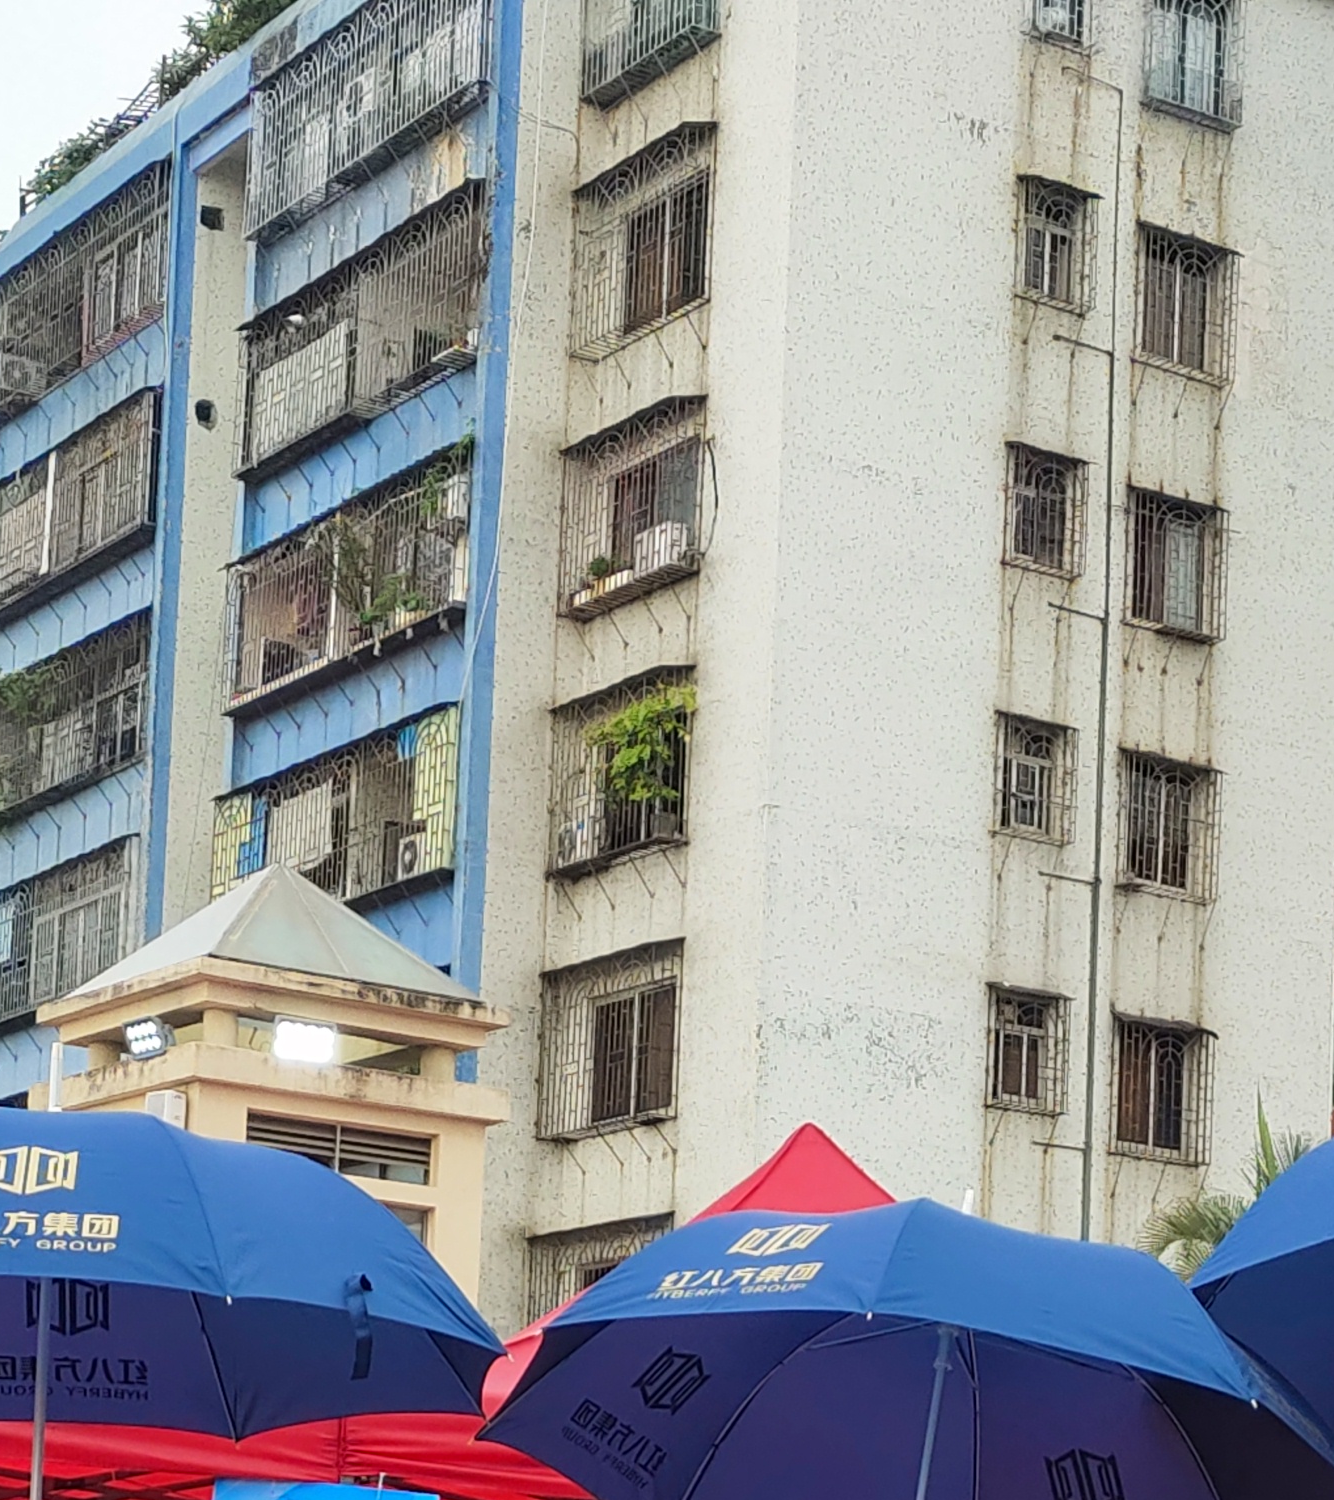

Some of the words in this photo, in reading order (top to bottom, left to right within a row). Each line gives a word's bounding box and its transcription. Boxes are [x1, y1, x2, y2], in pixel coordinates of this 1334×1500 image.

[36, 1238, 117, 1253] GROUP
[656, 1261, 825, 1291] 红八方集团
[739, 1282, 808, 1295] GROUP
